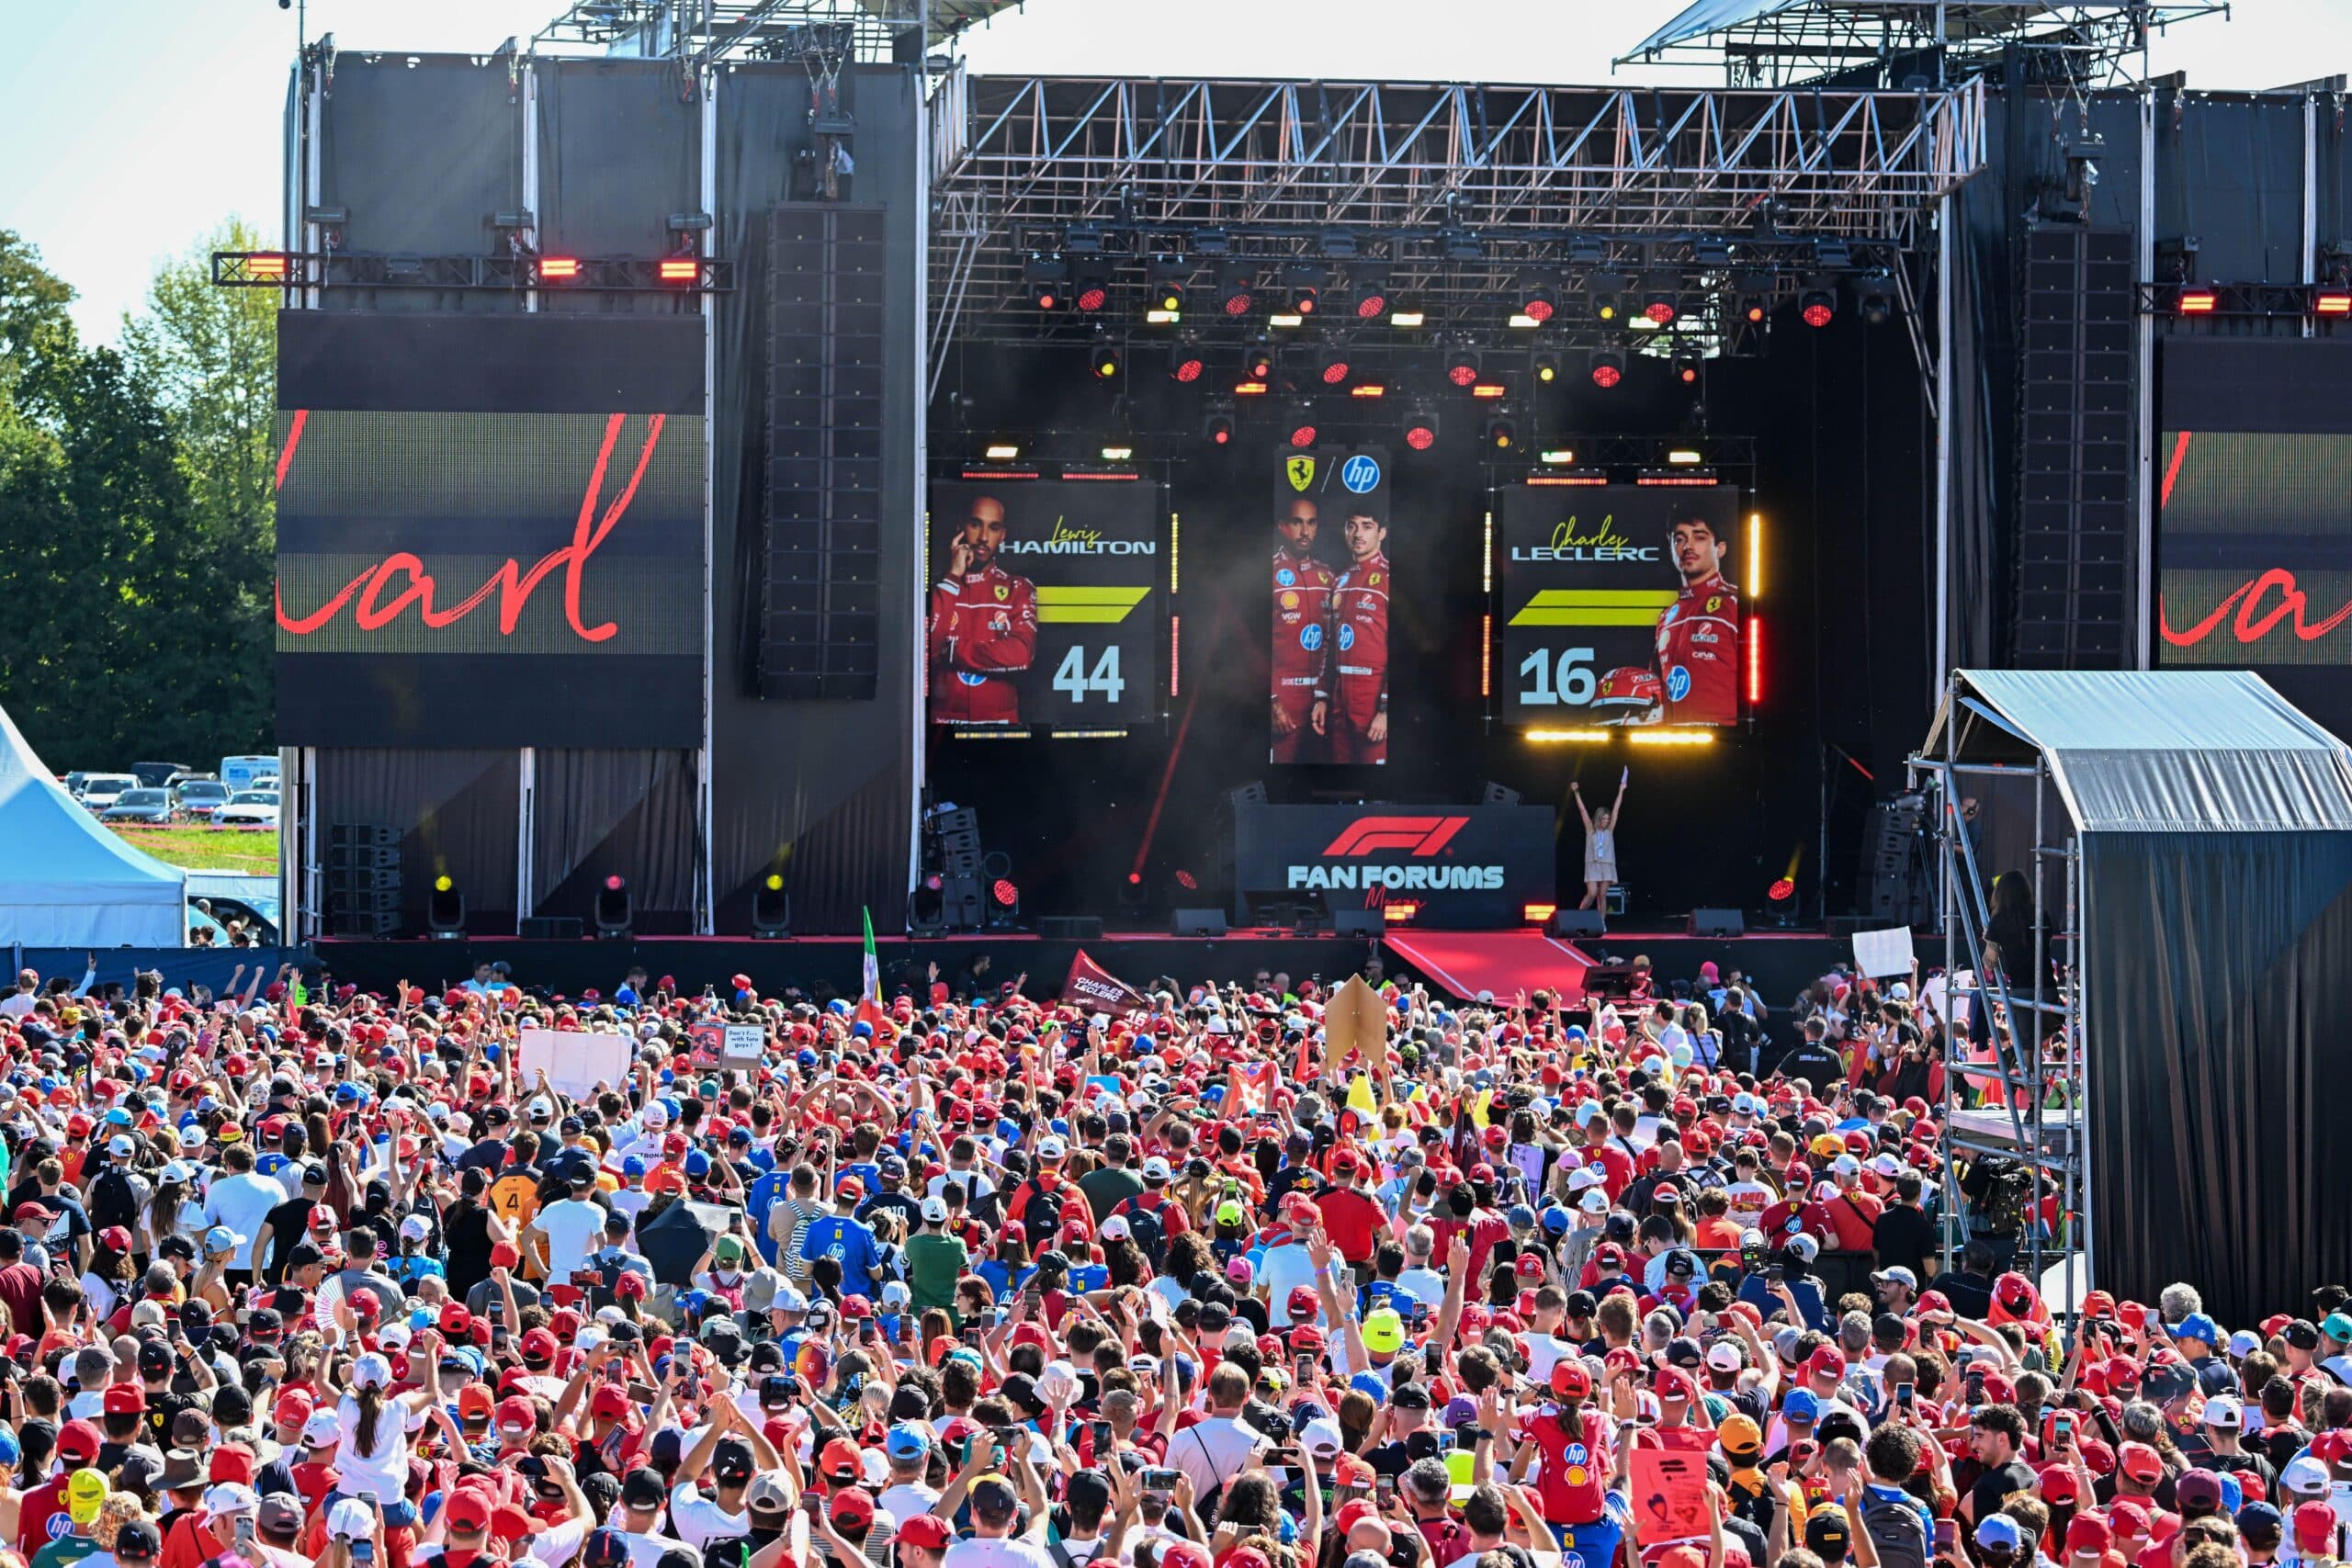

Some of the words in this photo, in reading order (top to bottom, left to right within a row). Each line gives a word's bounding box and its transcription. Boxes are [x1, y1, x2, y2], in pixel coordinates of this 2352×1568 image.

[1345, 457, 1377, 492] hp
[1050, 515, 1102, 548] Lewis
[1551, 514, 1629, 553] Charles
[999, 540, 1156, 555] HAMILTON
[1511, 547, 1659, 560] LECLERC
[1052, 646, 1125, 704] 44
[1520, 648, 1596, 705] 16
[1322, 817, 1471, 856] F1
[1287, 865, 1357, 889] FAN
[1363, 865, 1505, 889] FORUMS
[1073, 983, 1120, 1002] LECLERC
[1077, 976, 1125, 997] CHARLES
[1125, 1009, 1148, 1027] 16
[506, 1193, 519, 1211] 4
[1566, 1444, 1586, 1464] hp
[49, 1513, 73, 1540] hp
